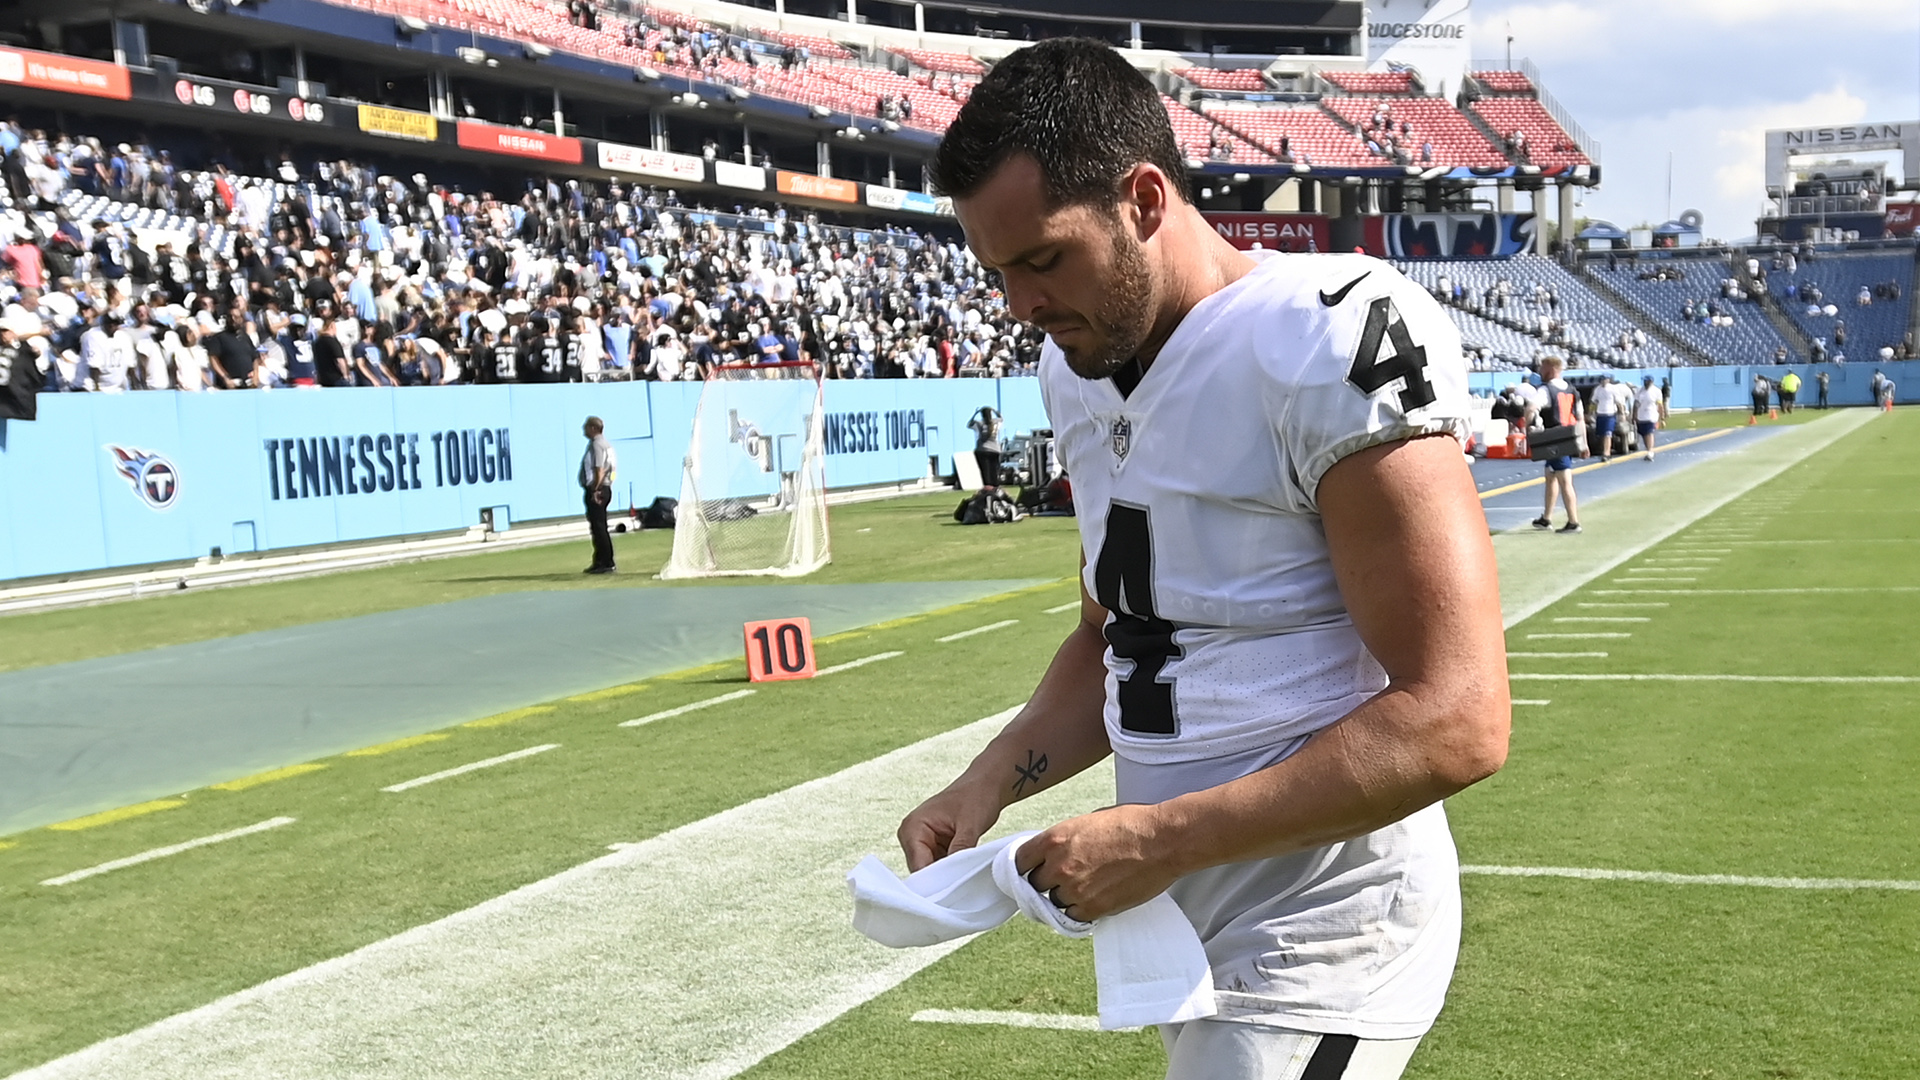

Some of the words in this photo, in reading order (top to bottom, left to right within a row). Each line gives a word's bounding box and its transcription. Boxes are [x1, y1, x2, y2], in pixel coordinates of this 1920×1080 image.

[1367, 23, 1466, 39] RIDGESTONE
[193, 85, 216, 106] LG
[250, 93, 272, 115] LG
[304, 102, 324, 123] LG
[498, 134, 547, 152] NISSAN
[1786, 124, 1902, 144] NISSAN
[1831, 180, 1881, 196] TITAN
[1217, 220, 1314, 239] NISSAN
[541, 348, 563, 374] 34
[1346, 295, 1438, 415] 4
[495, 354, 518, 379] 21
[803, 410, 879, 456] TNNESSEE
[263, 432, 422, 501] TENNESSEE
[431, 427, 513, 488] TOUGH
[1093, 500, 1184, 736] 4
[753, 624, 806, 675] 10
